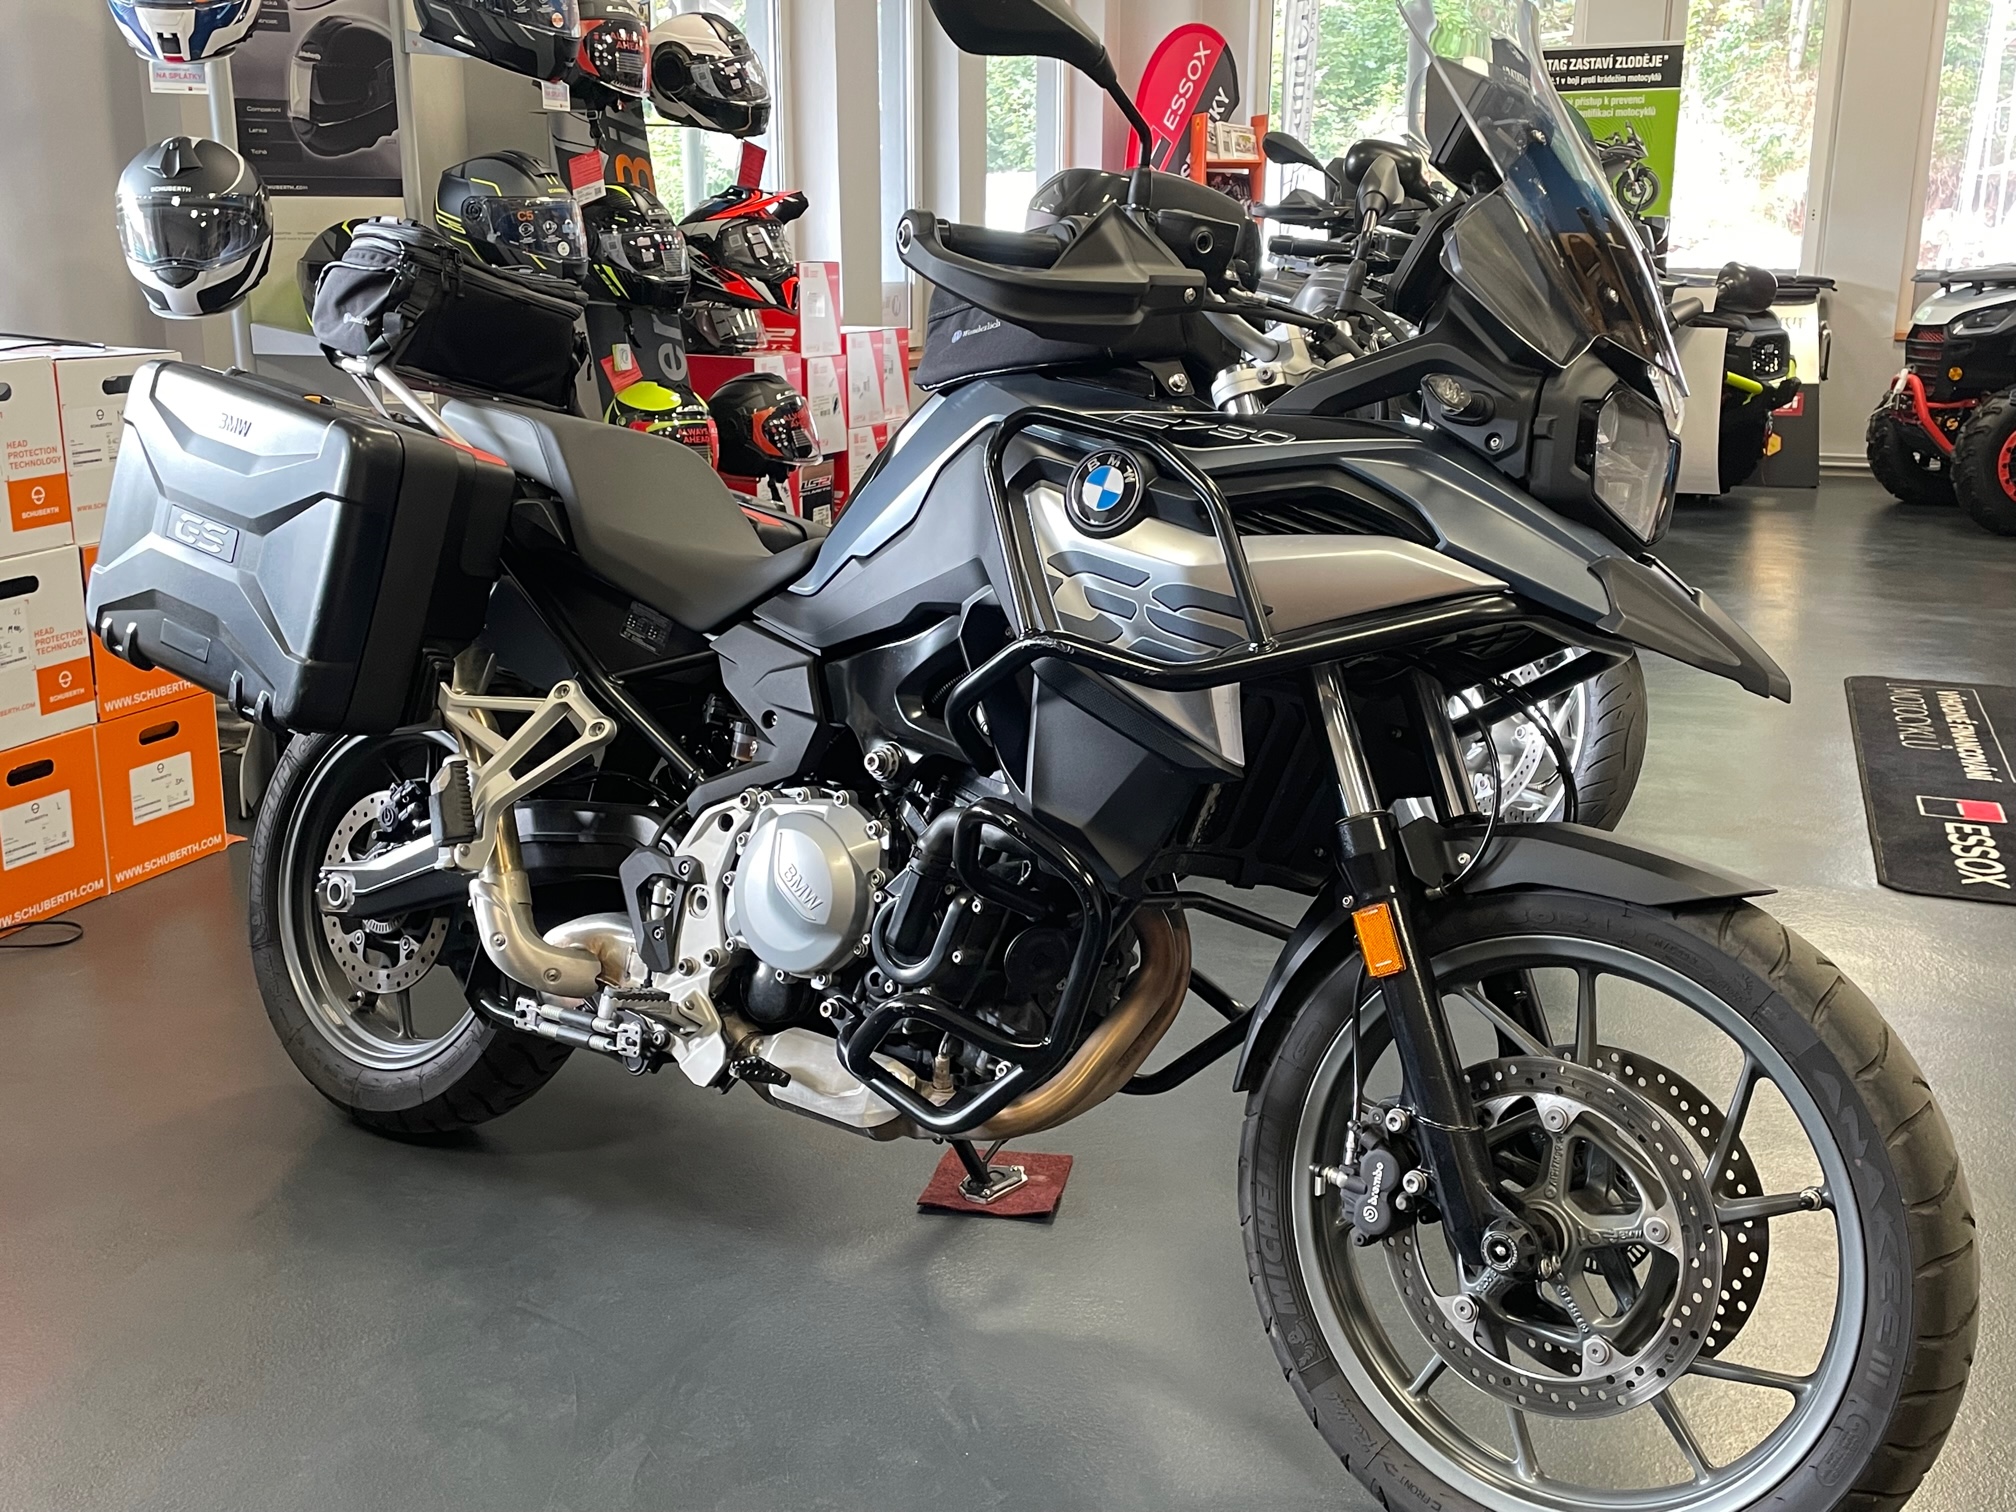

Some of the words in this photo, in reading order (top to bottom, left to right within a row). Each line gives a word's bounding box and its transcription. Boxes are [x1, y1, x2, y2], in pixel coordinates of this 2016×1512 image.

[1569, 54, 1614, 71] ZASTAVÍ
[1163, 40, 1212, 132] ESSOX
[1580, 75, 1597, 86] proti
[1627, 72, 1662, 84] motocyklů
[1604, 96, 1610, 105] k
[1610, 95, 1645, 106] prevenci
[1615, 106, 1656, 119] motocyklů
[516, 211, 534, 221] C5
[962, 318, 1001, 338] Wunderlich
[218, 412, 252, 437] BMW
[6, 440, 28, 449] HEAD
[683, 435, 711, 444] AHEAD
[8, 446, 58, 459] PROTECTION
[9, 456, 62, 470] TECHNOLOGY
[1086, 453, 1136, 484] BMW
[801, 476, 833, 490] LS2
[21, 506, 60, 519] SCHUBERTH
[77, 502, 107, 512] WWW.SCH
[174, 512, 230, 553] GS
[34, 627, 55, 638] HEAD
[35, 628, 84, 647] PROTECTION
[36, 637, 87, 656] TECHNOLOGY
[49, 687, 85, 703] SCHUBERTH
[104, 679, 196, 713] WWW.SCHUBERTH.
[1936, 690, 1980, 726] VÝHODNÉ
[1888, 687, 1953, 751] MOTOCYKLŮ
[1949, 722, 2002, 783] FINANCOVÁNÍ
[253, 760, 296, 903] MICHELIN
[115, 833, 222, 883] WWW.SCHUBERTH.COM
[1944, 822, 2011, 889] ESSOX
[783, 863, 824, 911] BMW
[1367, 1162, 1384, 1206] brembo
[1255, 1115, 1298, 1315] MICHELIN
[1399, 1475, 1432, 1505] FRONT
